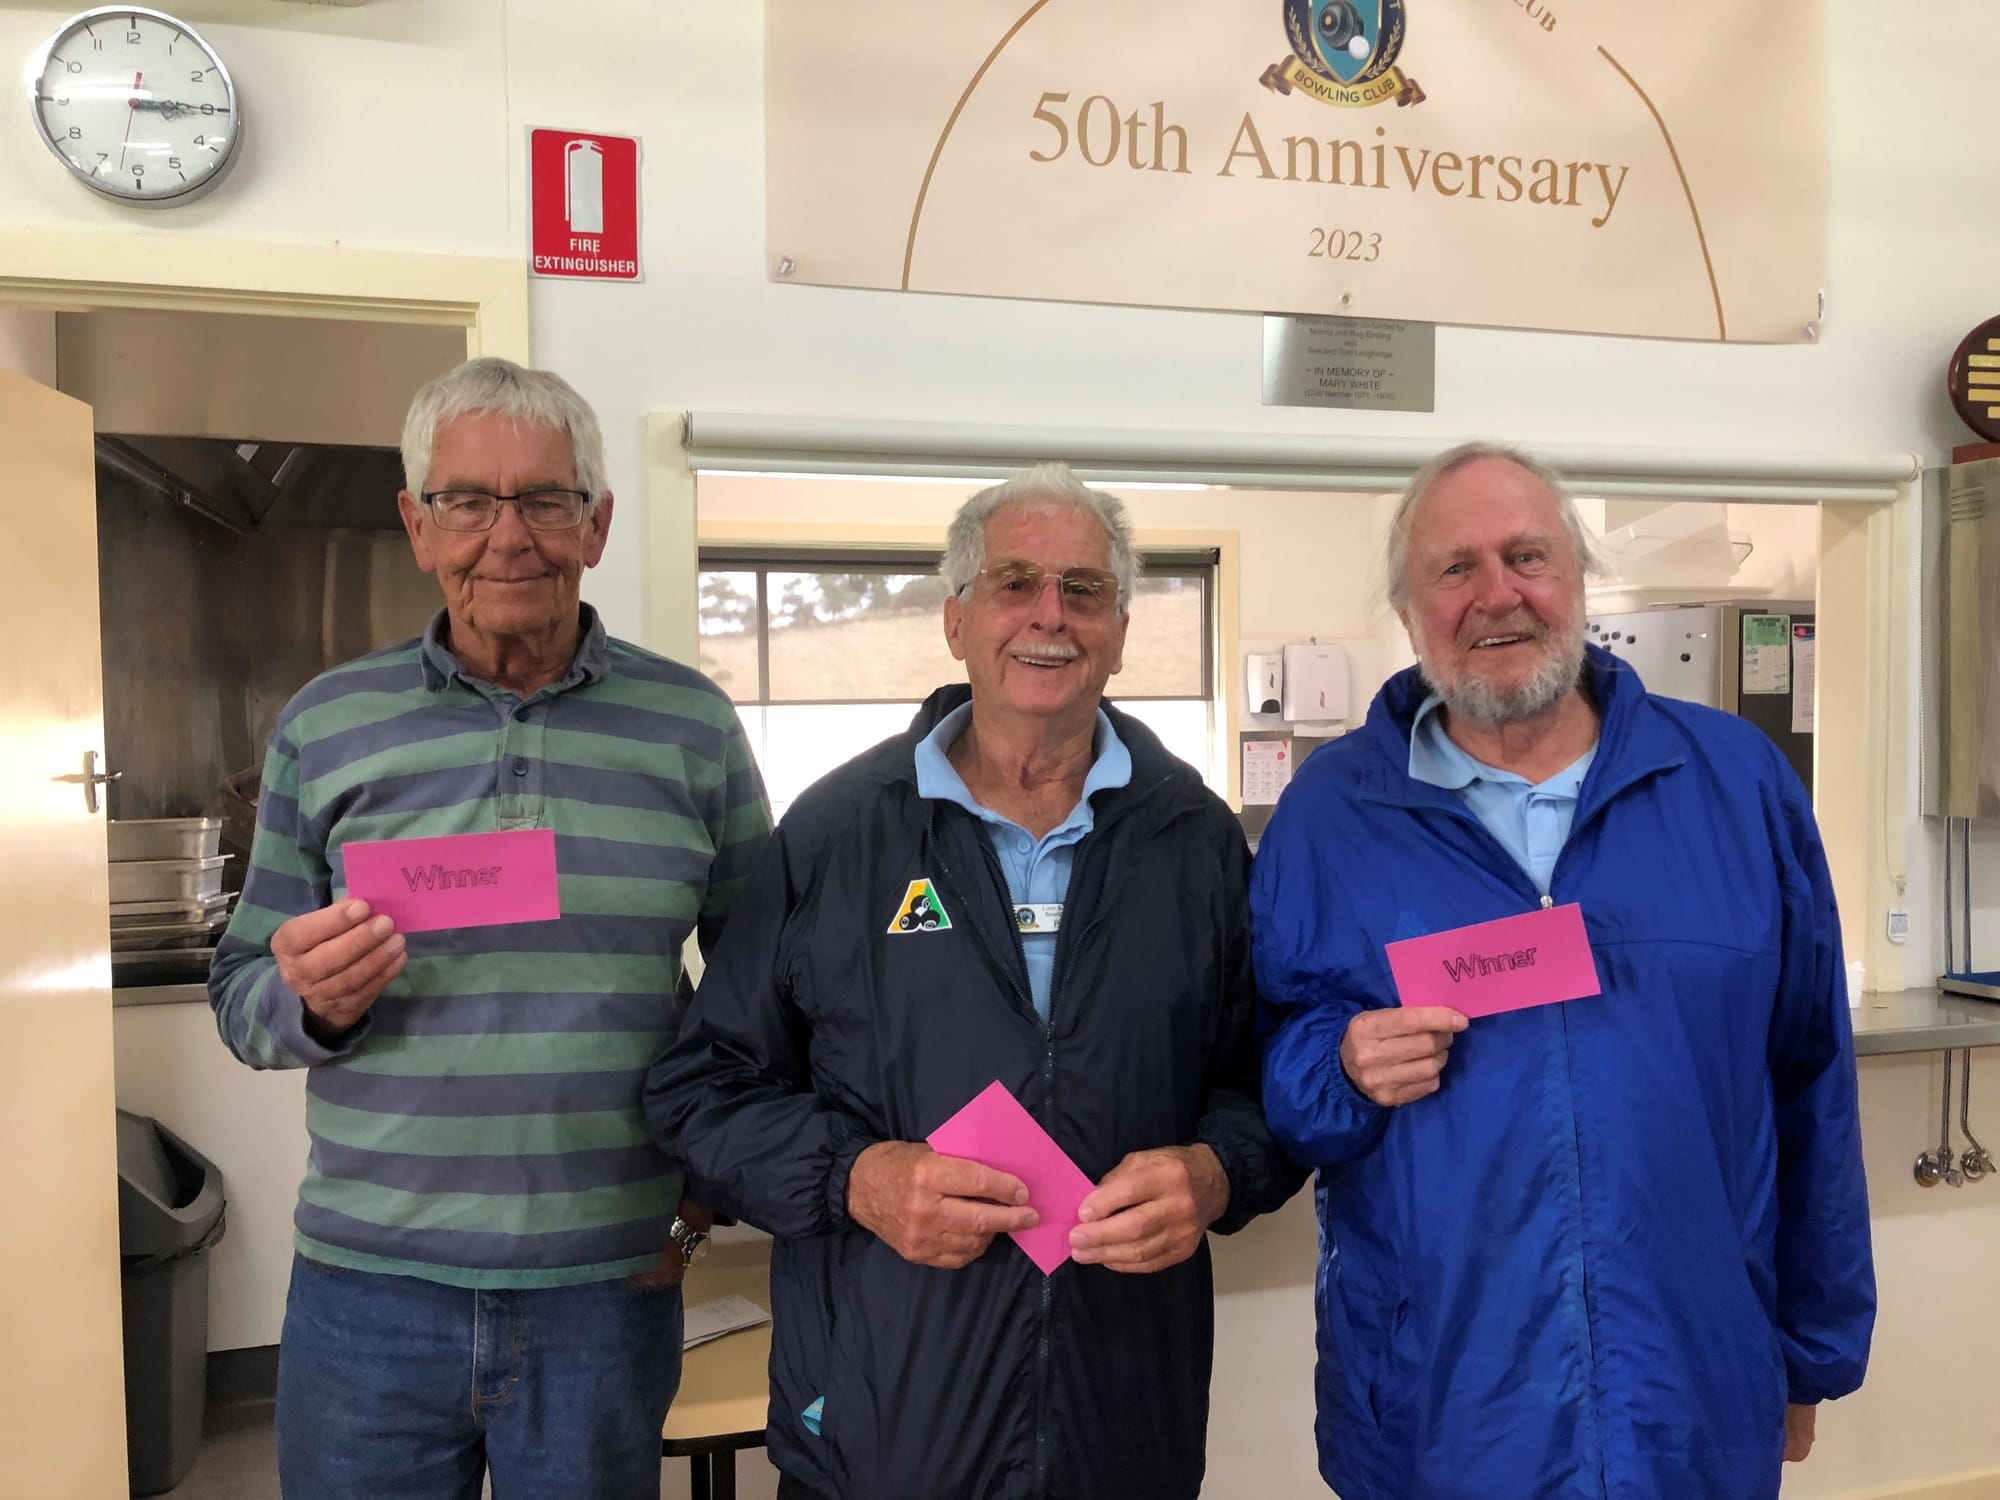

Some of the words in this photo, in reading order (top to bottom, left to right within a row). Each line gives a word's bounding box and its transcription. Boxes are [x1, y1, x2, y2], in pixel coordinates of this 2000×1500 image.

[93, 38, 102, 50] 11
[126, 31, 141, 45] 12
[66, 61, 82, 74] 10
[190, 70, 204, 83] 2
[1294, 69, 1360, 103] BOWLING
[1363, 78, 1396, 101] CLUB
[69, 126, 82, 140] 8
[193, 134, 205, 146] 4
[96, 152, 109, 165] 7
[168, 156, 182, 170] 5
[1029, 91, 1192, 174] 50th
[1216, 111, 1630, 228] Anniversary
[131, 163, 145, 177] 6
[569, 238, 601, 252] FIRE
[1308, 227, 1382, 262] 2023
[535, 255, 636, 273] EXTINGUISHER
[1314, 367, 1324, 376] IN
[1327, 367, 1369, 377] MEMORY
[1373, 368, 1386, 378] OF
[1320, 378, 1346, 388] MARY
[1350, 379, 1381, 391] WHITE
[401, 864, 502, 893] Winner
[1442, 948, 1537, 983] Winner
